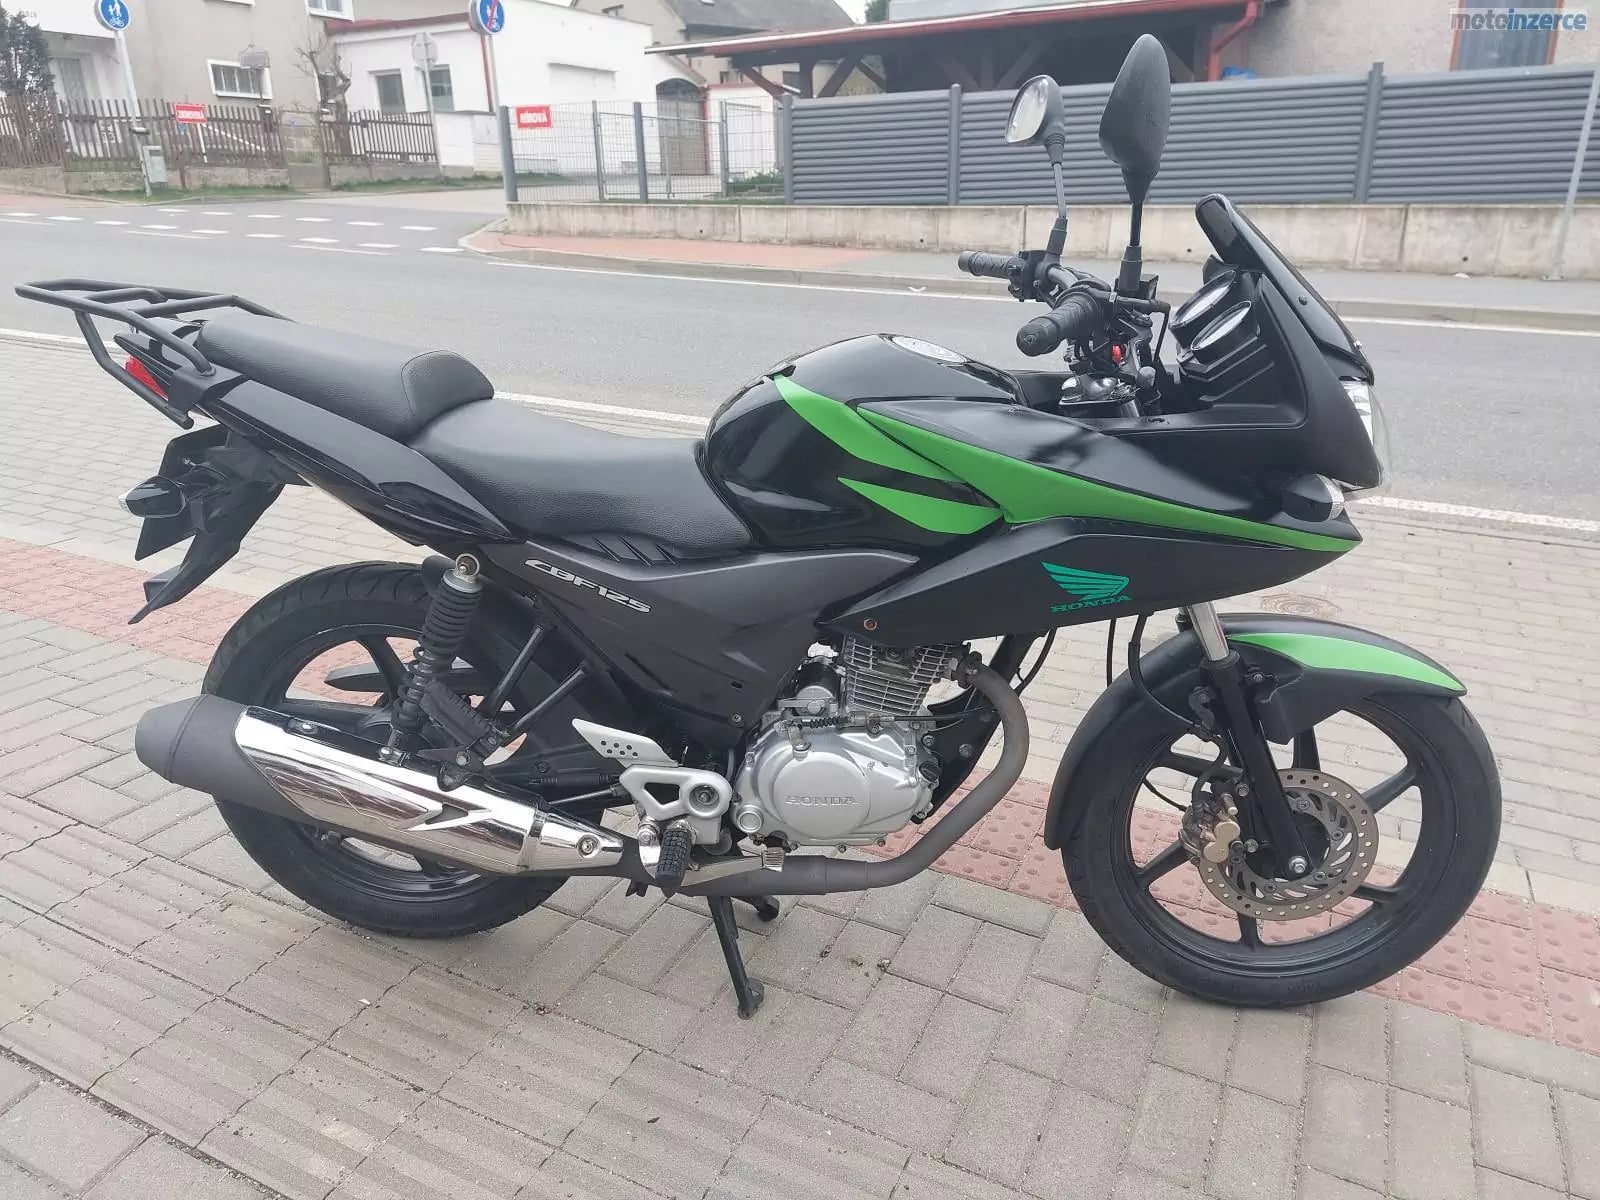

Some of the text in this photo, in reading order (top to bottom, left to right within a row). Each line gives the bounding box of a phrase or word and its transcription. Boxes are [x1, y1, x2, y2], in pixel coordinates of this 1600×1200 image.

[524, 559, 652, 613] CBF125
[1050, 595, 1133, 613] HONDA
[785, 795, 860, 806] HONDA
